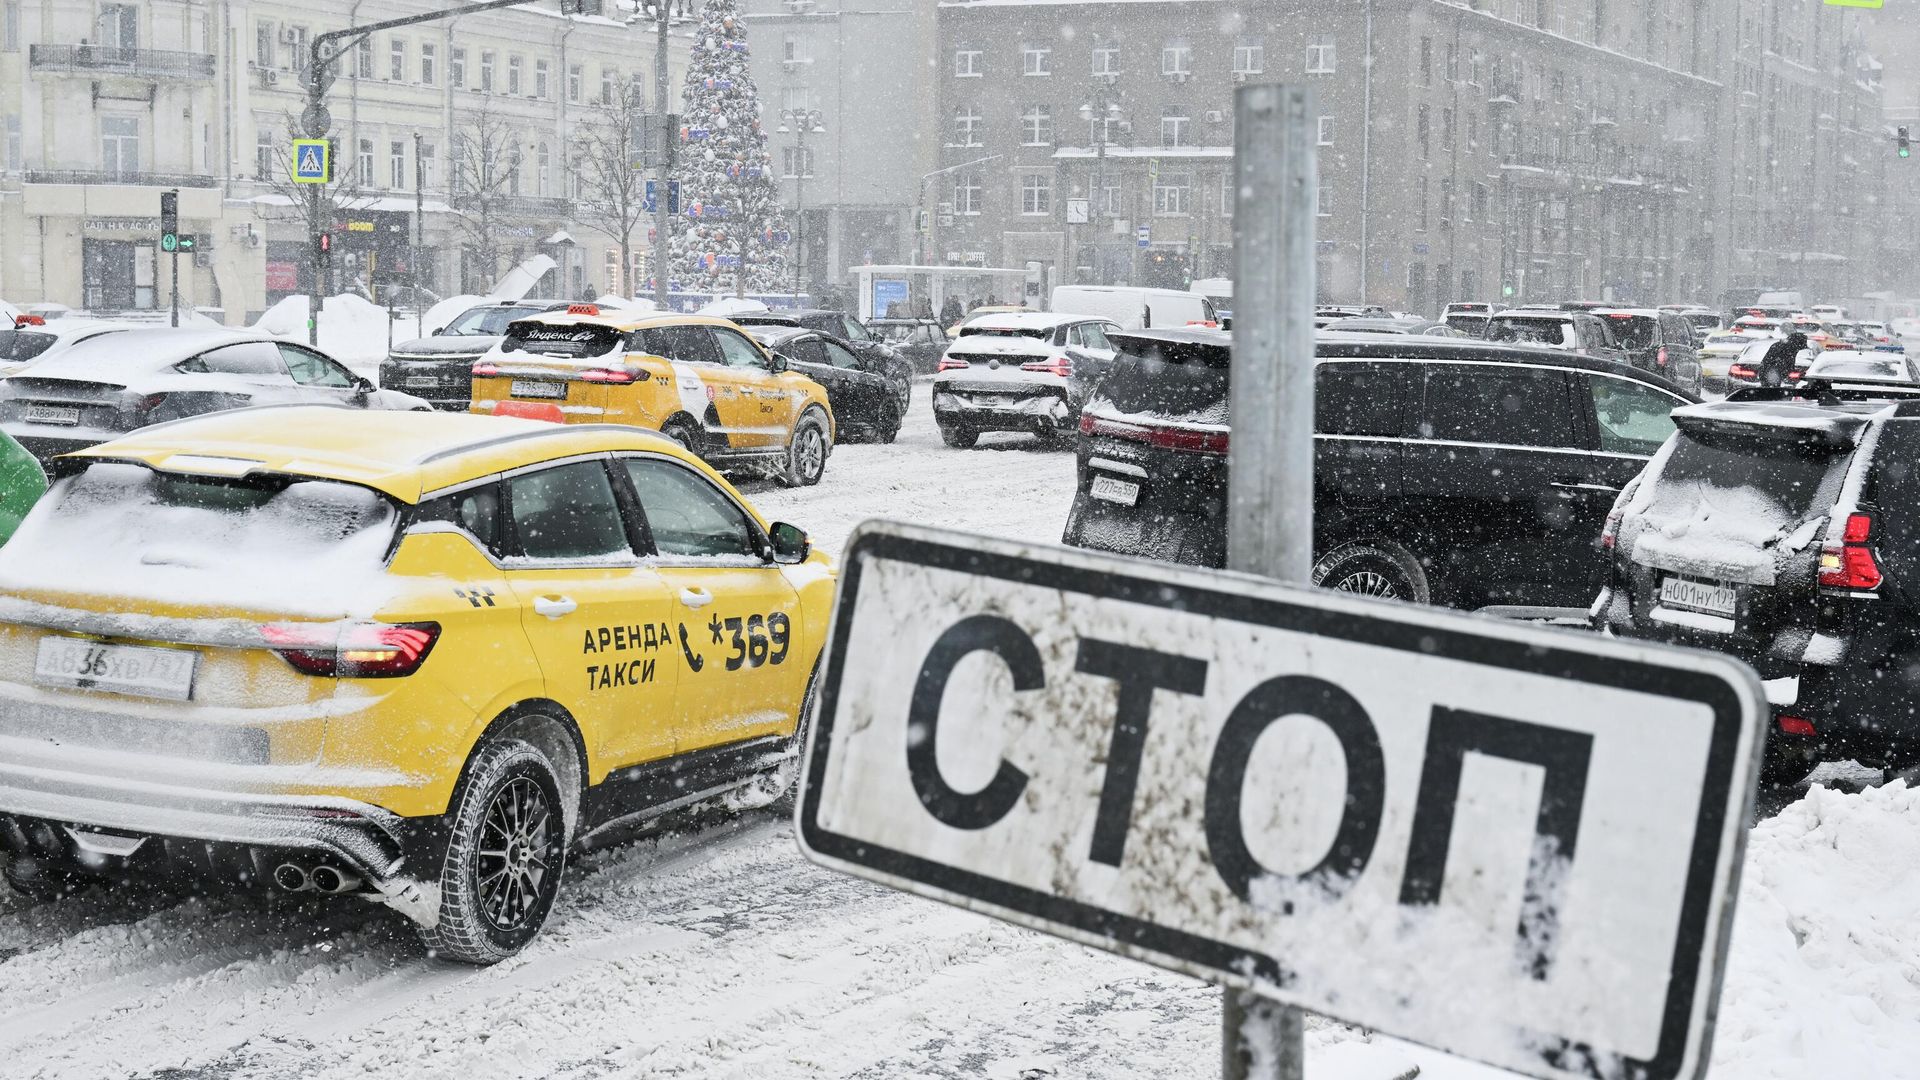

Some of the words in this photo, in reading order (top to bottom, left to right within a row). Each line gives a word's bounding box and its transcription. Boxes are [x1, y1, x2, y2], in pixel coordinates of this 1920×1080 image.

[84, 221, 115, 231] САЛН
[526, 329, 573, 340] Яндекс
[583, 622, 672, 654] АРЕНДА
[586, 658, 656, 691] ТАКСИ
[906, 613, 1595, 981] СТОП
